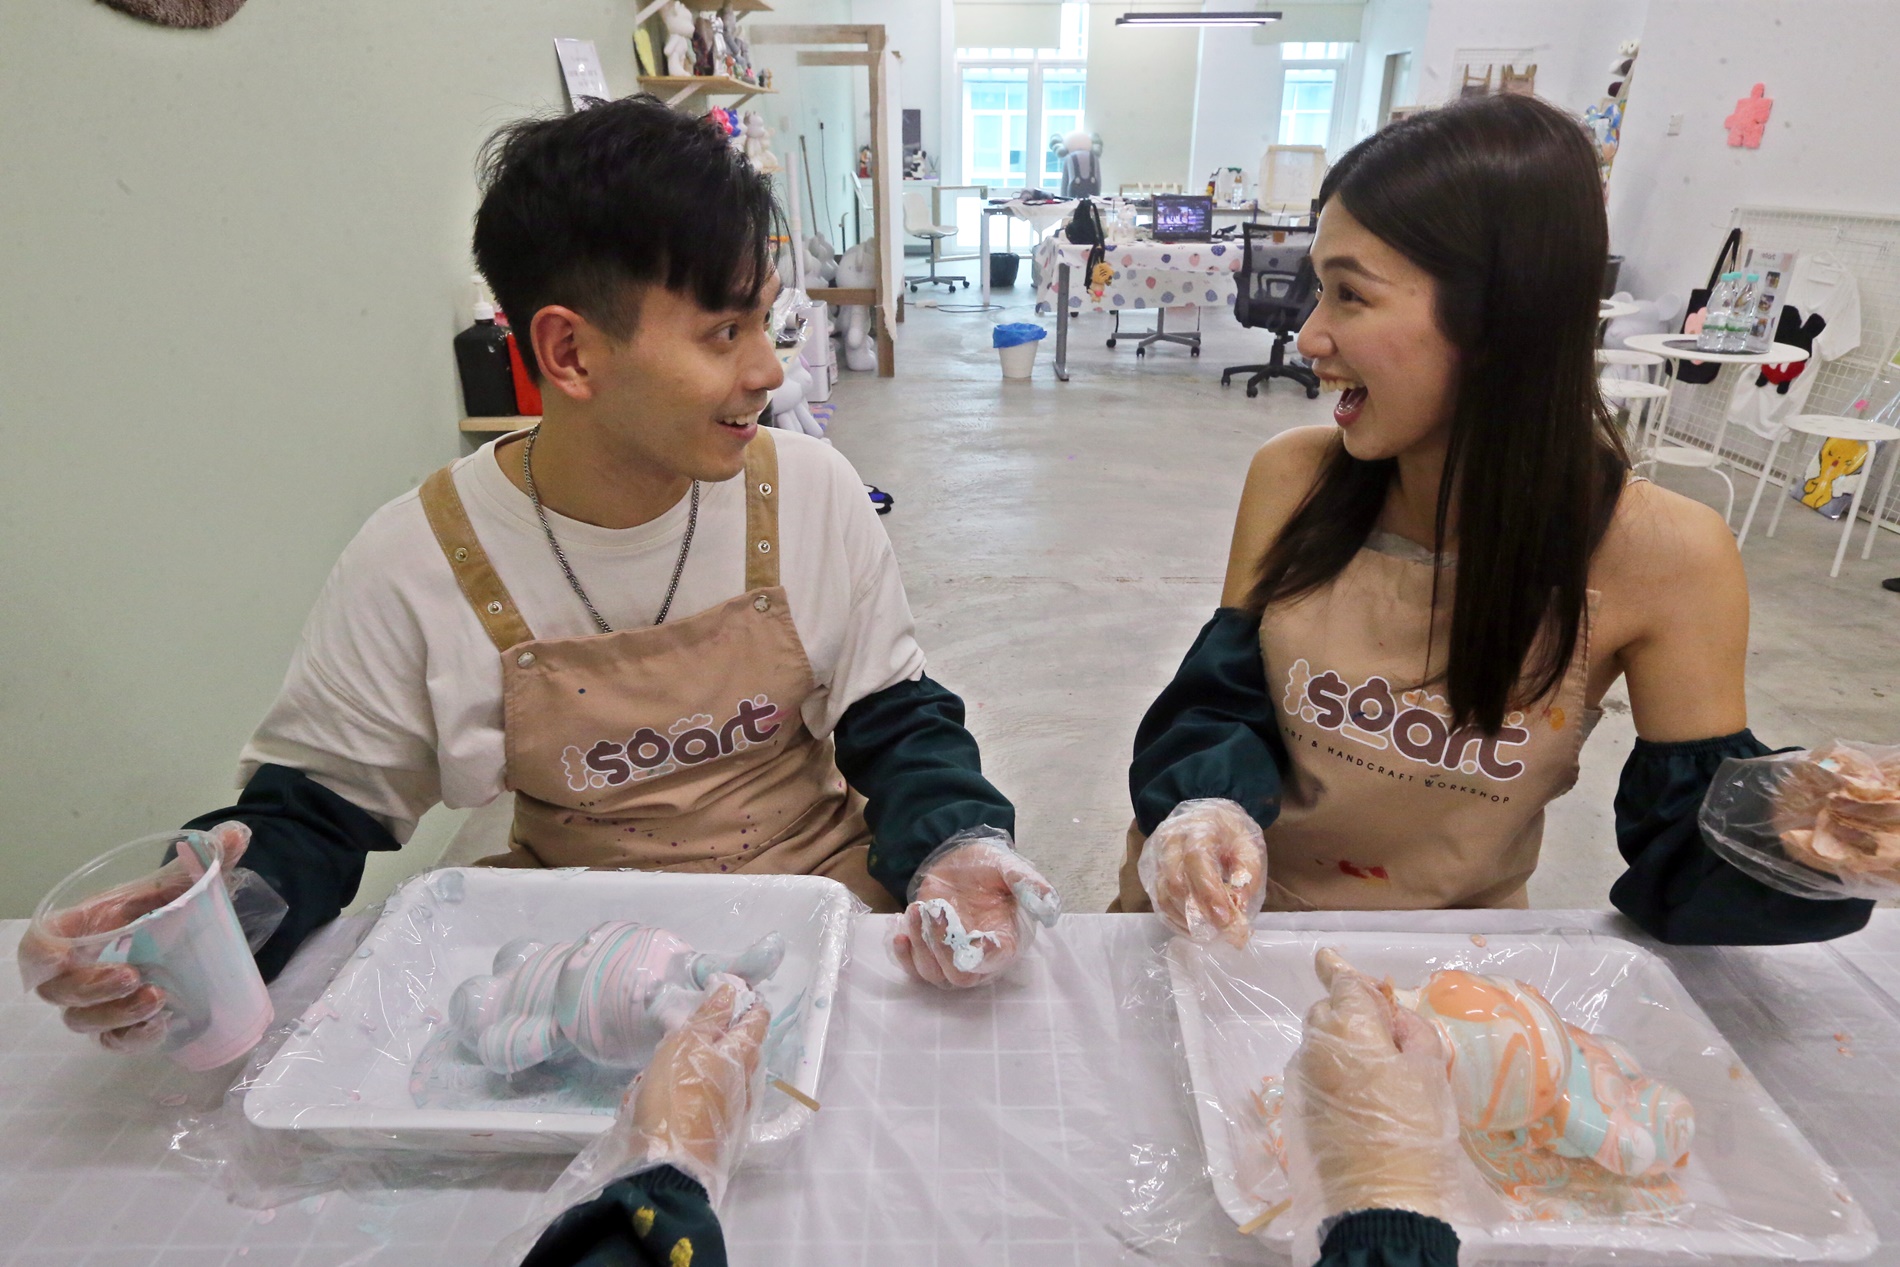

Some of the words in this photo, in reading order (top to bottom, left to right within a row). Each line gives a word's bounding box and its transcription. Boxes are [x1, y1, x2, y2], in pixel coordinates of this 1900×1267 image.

[585, 697, 781, 787] soart
[1311, 740, 1318, 748] &
[1327, 746, 1414, 782] HANDCRAFT
[1424, 779, 1510, 804] WORKSHOP
